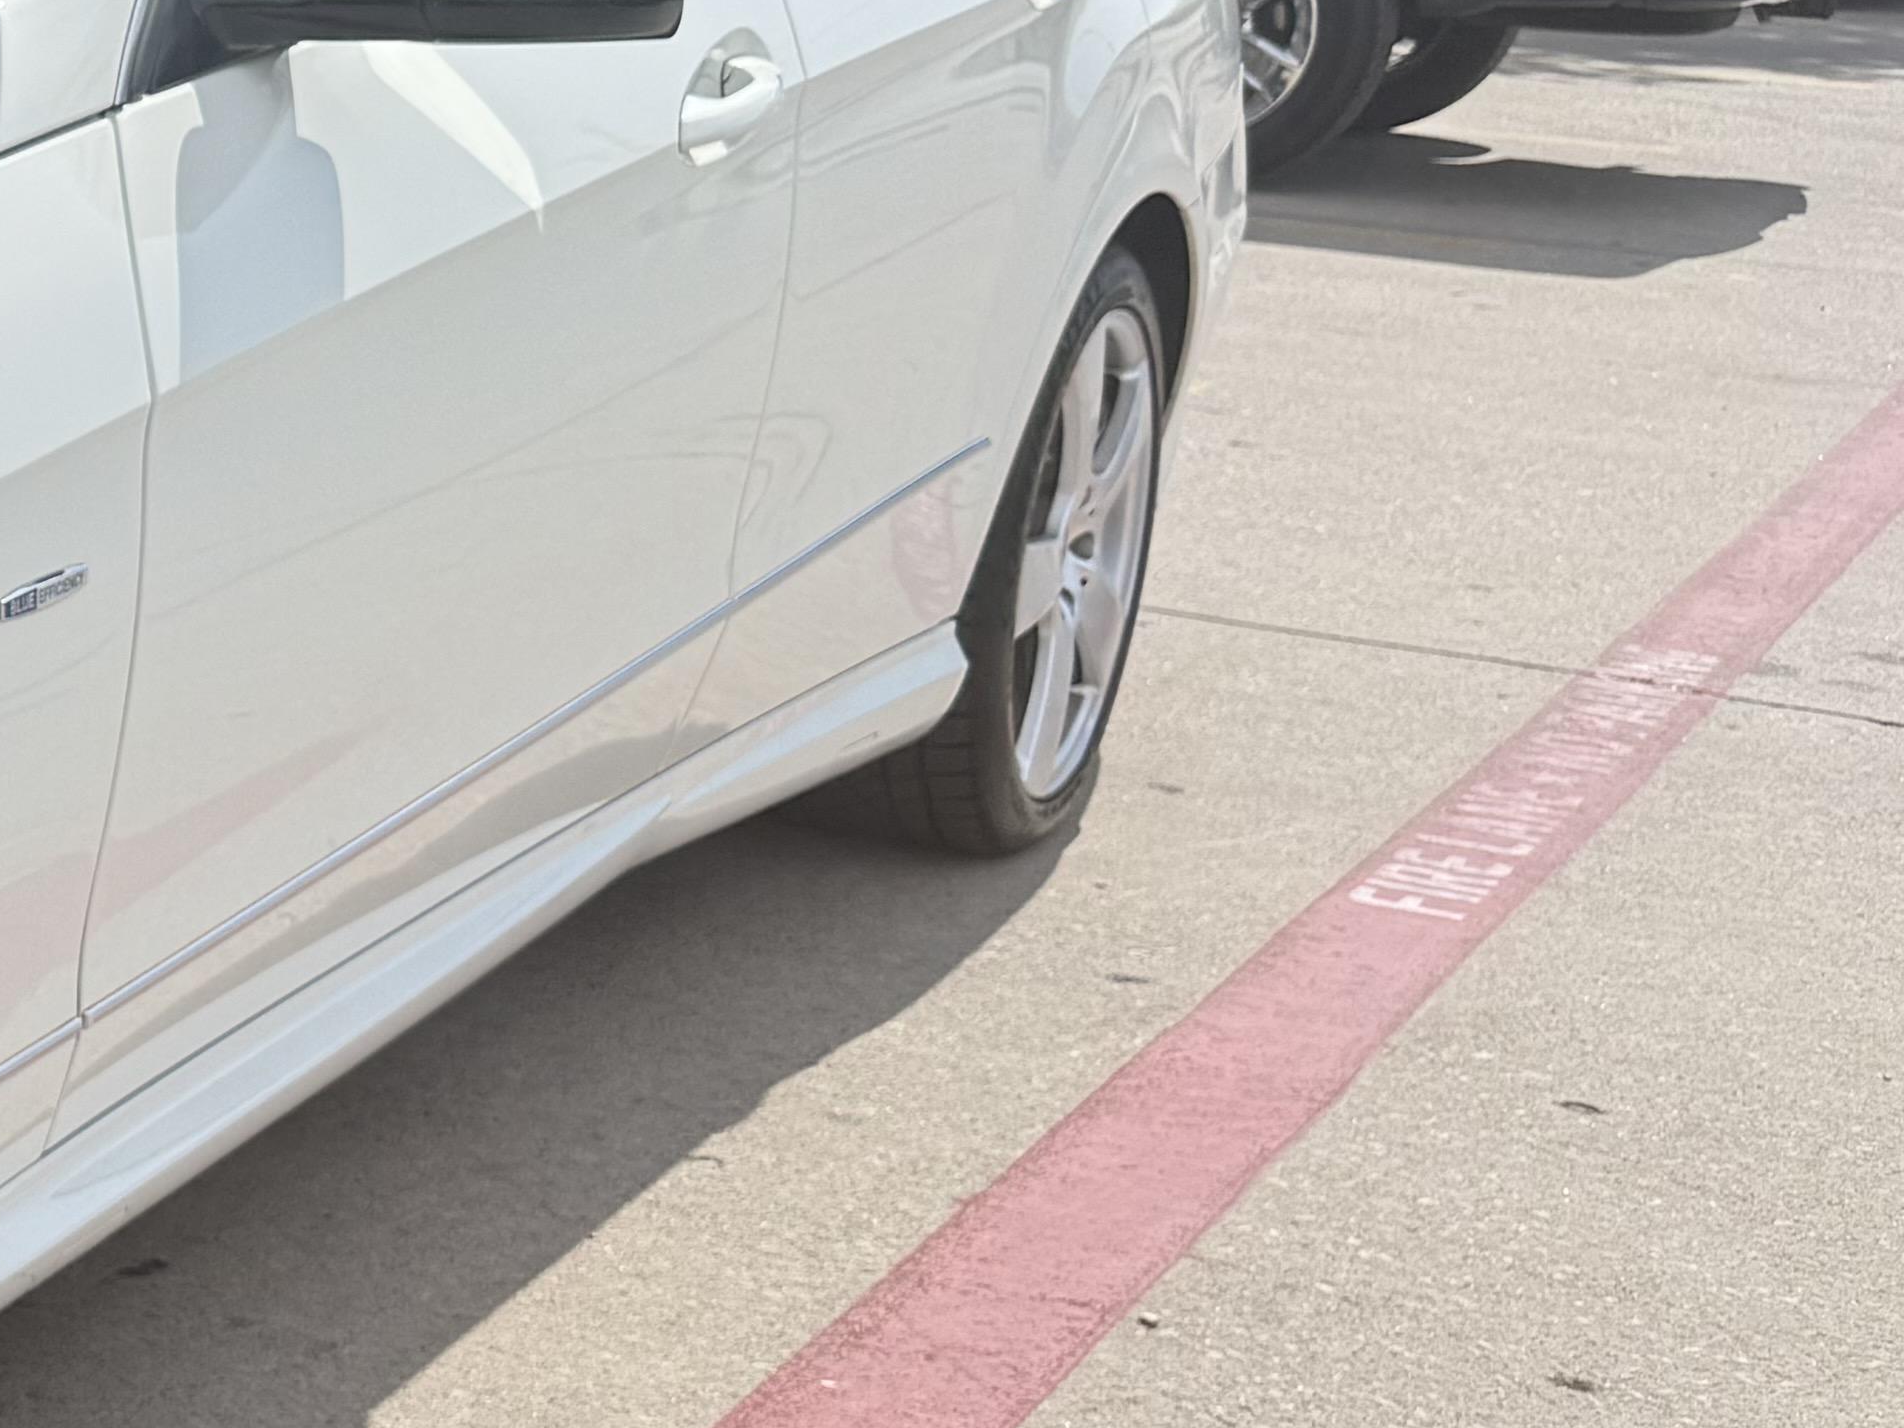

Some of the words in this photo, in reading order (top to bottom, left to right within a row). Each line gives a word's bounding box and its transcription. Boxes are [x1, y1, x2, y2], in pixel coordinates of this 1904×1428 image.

[10, 590, 35, 616] BLUE
[38, 572, 85, 604] EFFICIENCY
[1416, 782, 1584, 857] LANE
[1348, 847, 1515, 920] FIRE
